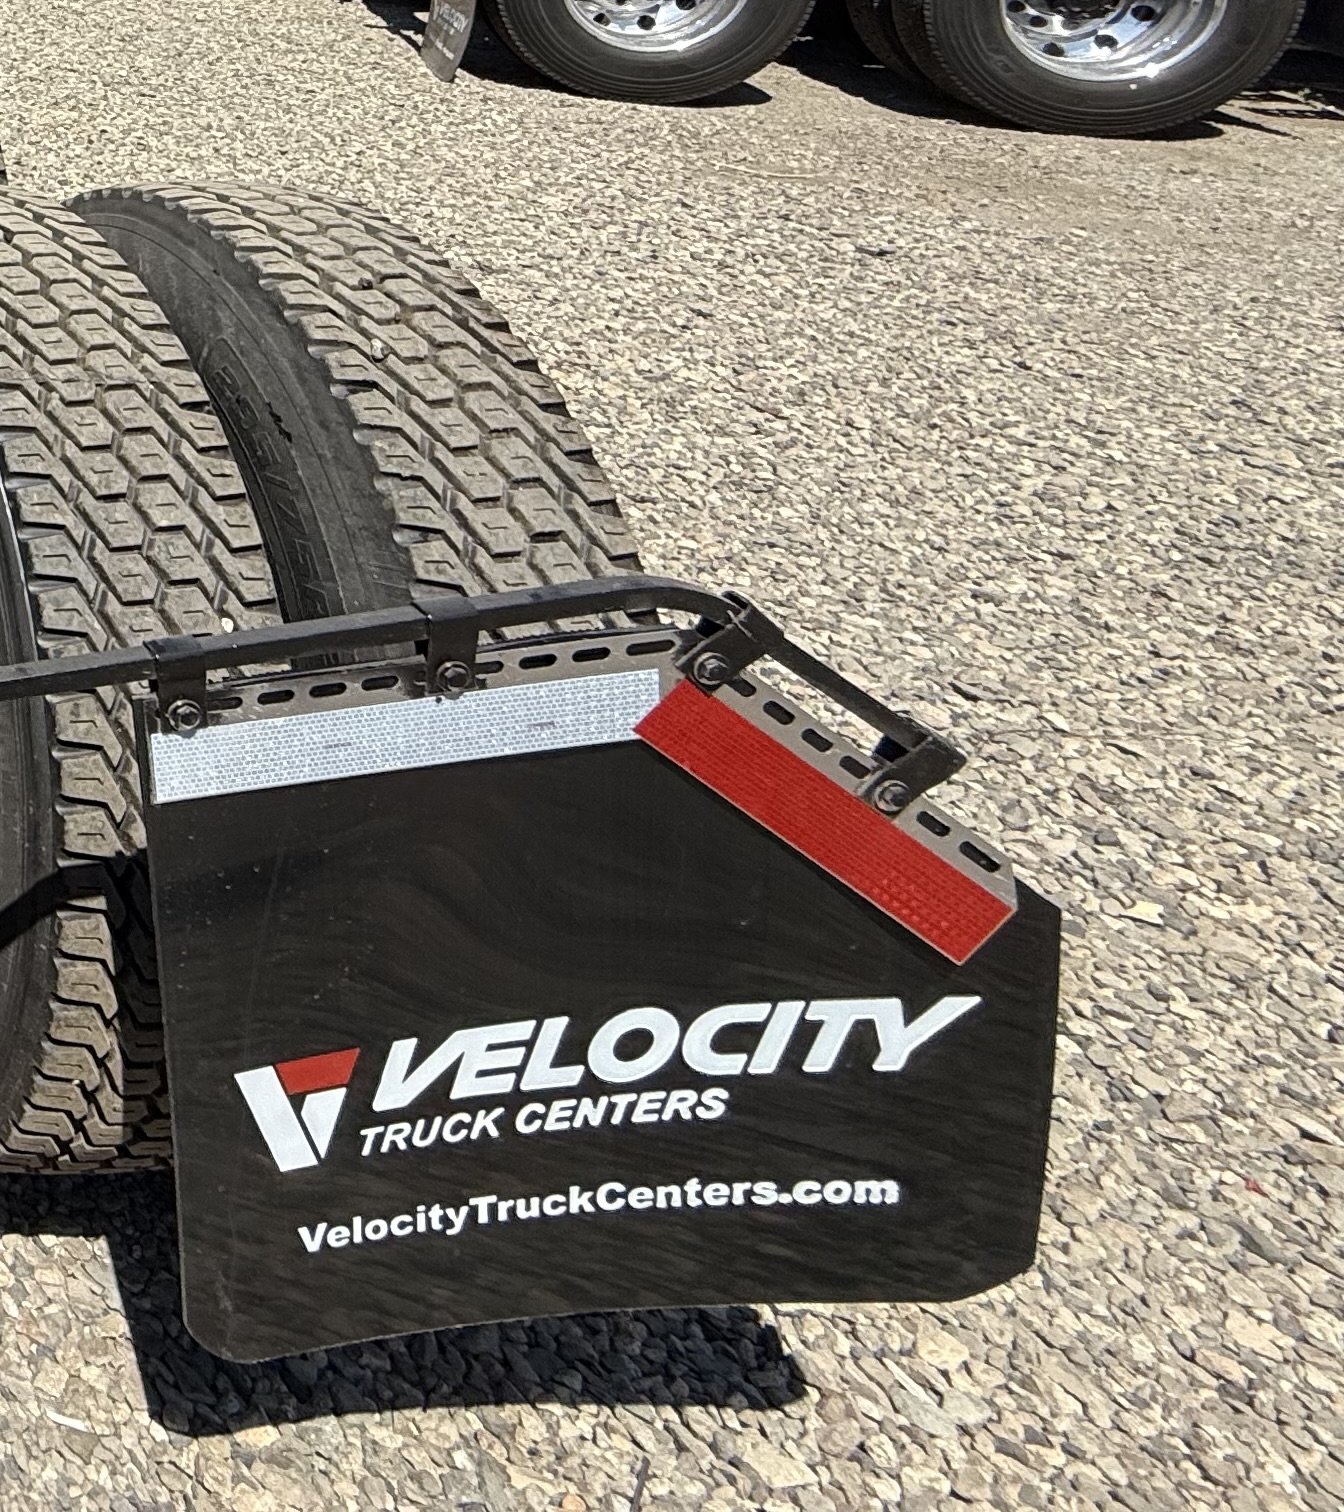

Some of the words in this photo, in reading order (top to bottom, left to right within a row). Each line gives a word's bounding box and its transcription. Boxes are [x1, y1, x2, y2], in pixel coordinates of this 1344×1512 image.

[372, 995, 982, 1113] VELOCITY
[359, 1106, 504, 1157] TRUCK
[514, 1087, 730, 1136] CENTERS
[298, 1177, 901, 1253] VelocityTruckCenters.com
